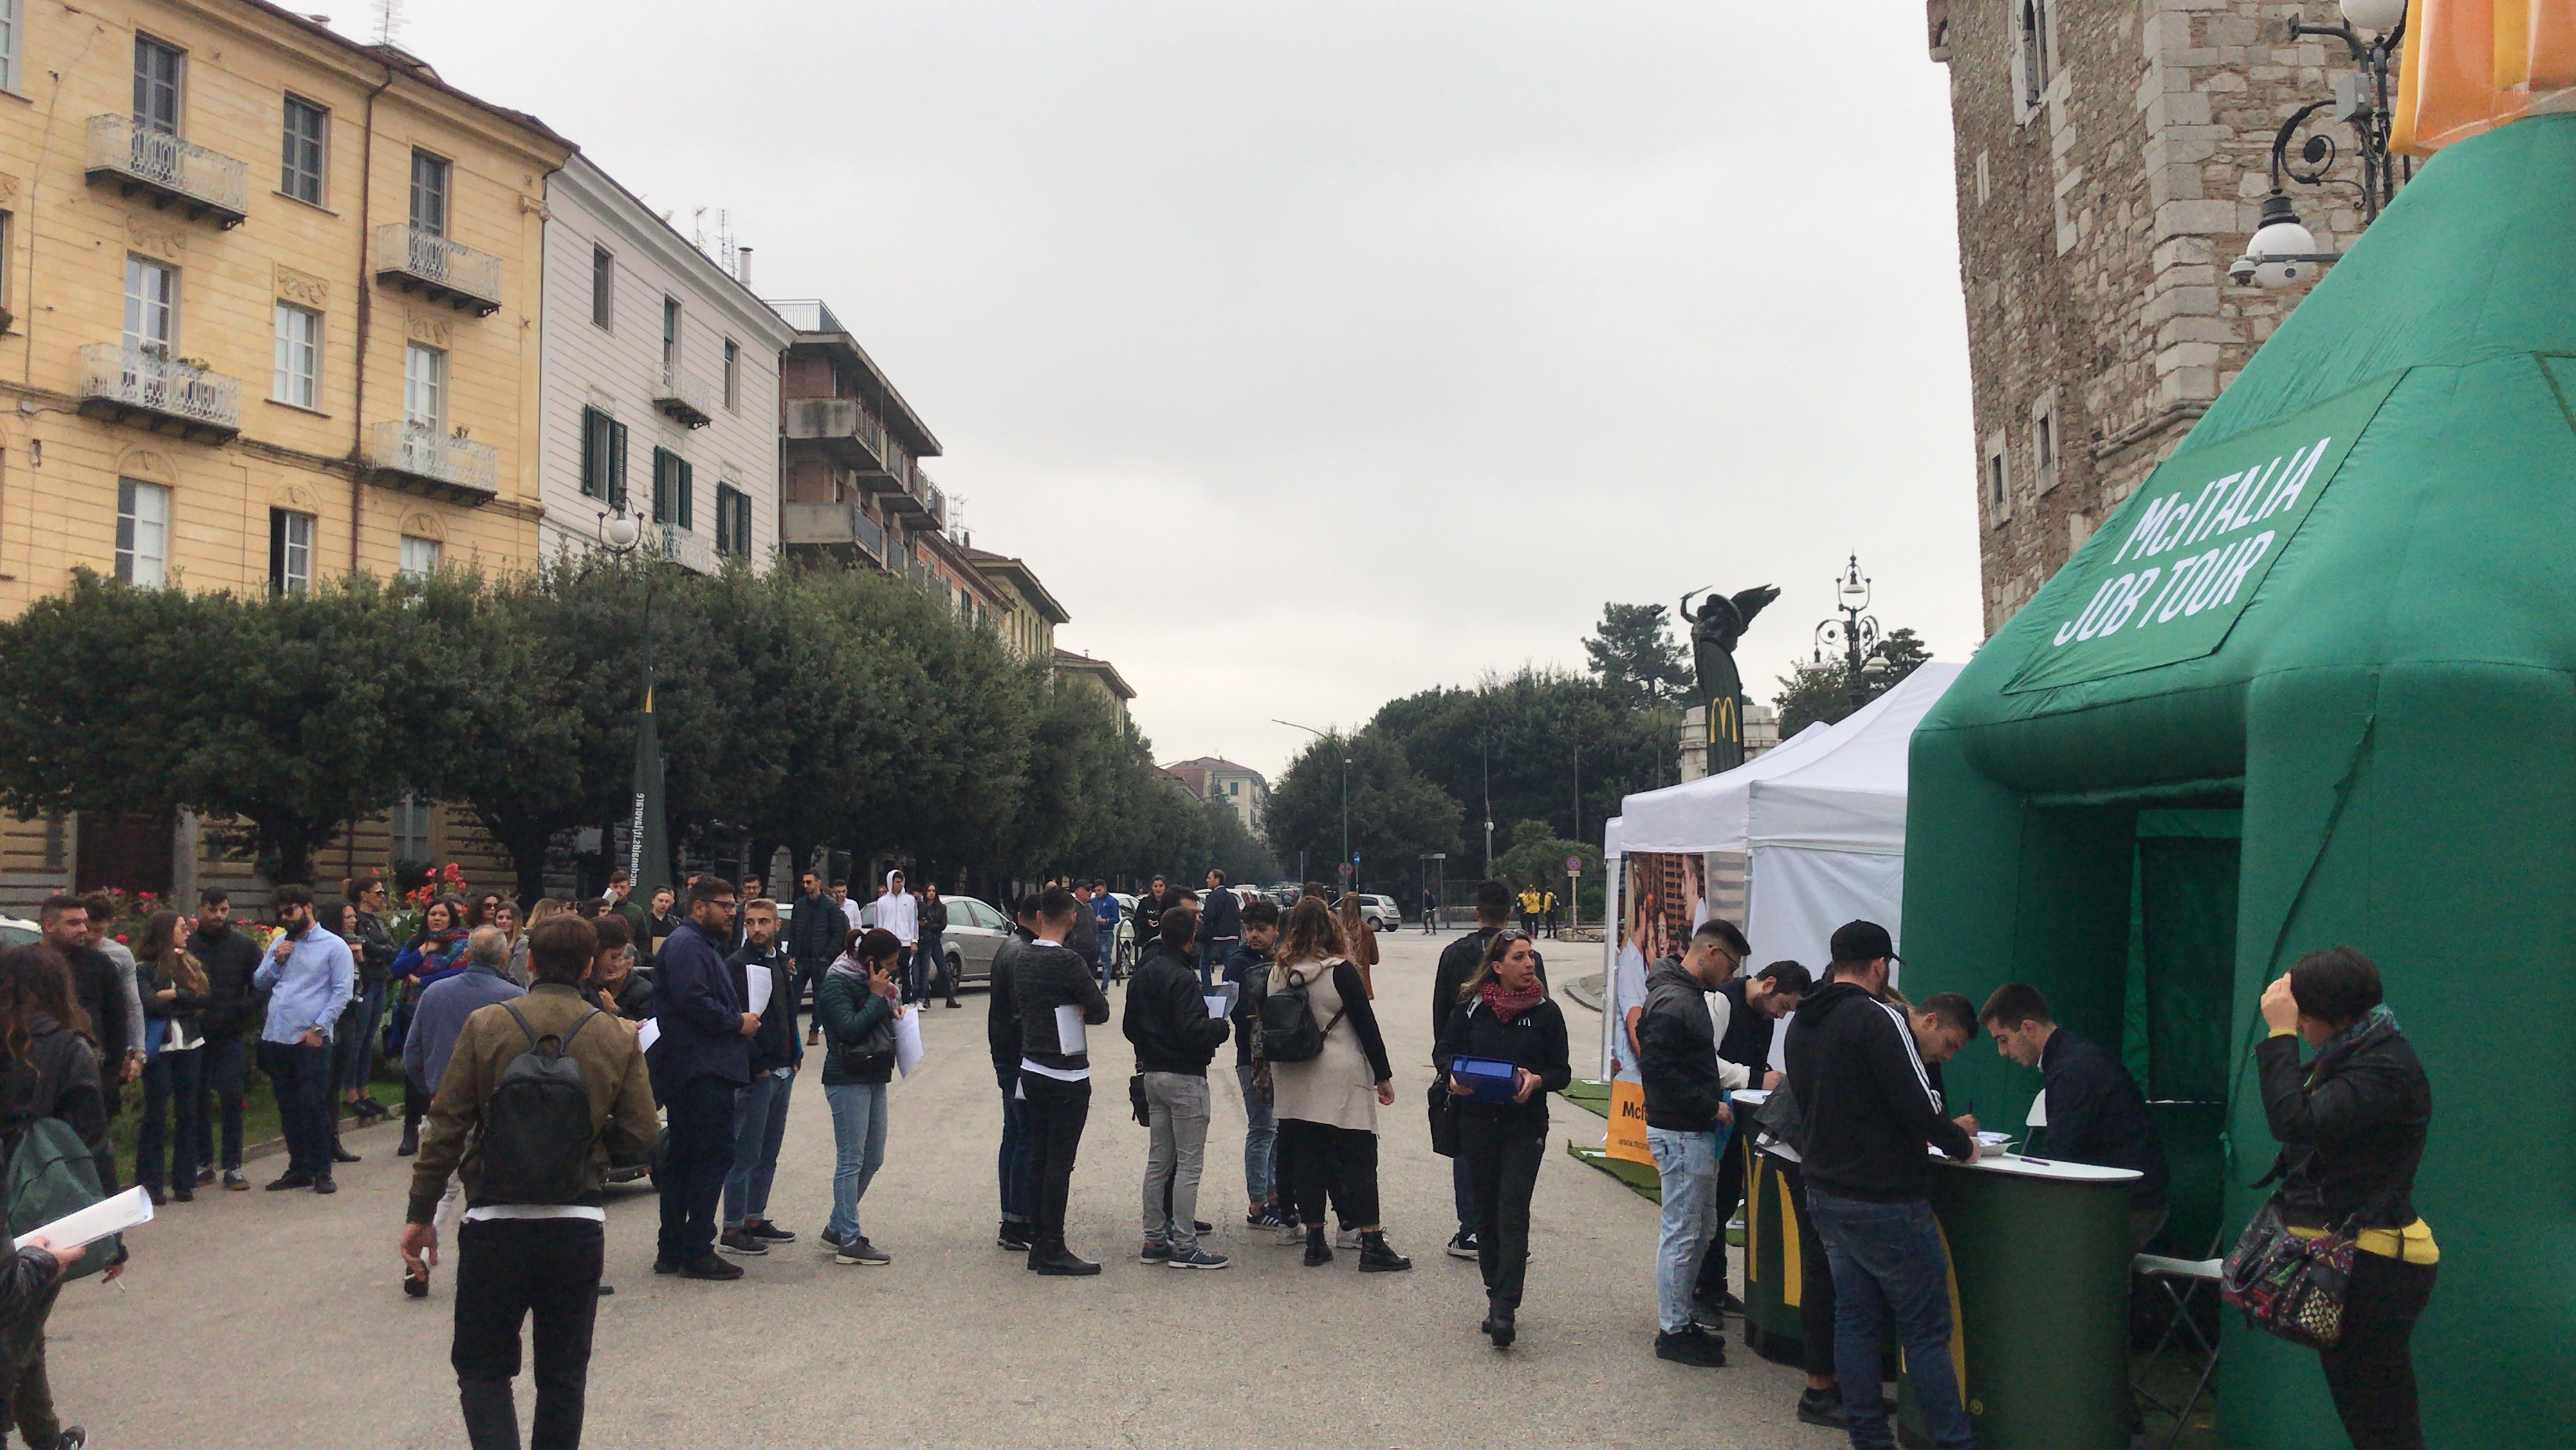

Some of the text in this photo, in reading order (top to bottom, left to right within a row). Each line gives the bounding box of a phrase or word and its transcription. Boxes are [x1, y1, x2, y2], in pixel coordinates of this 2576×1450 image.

[2111, 436, 2331, 565] McITALIA
[2054, 530, 2275, 647] JOB TOUR
